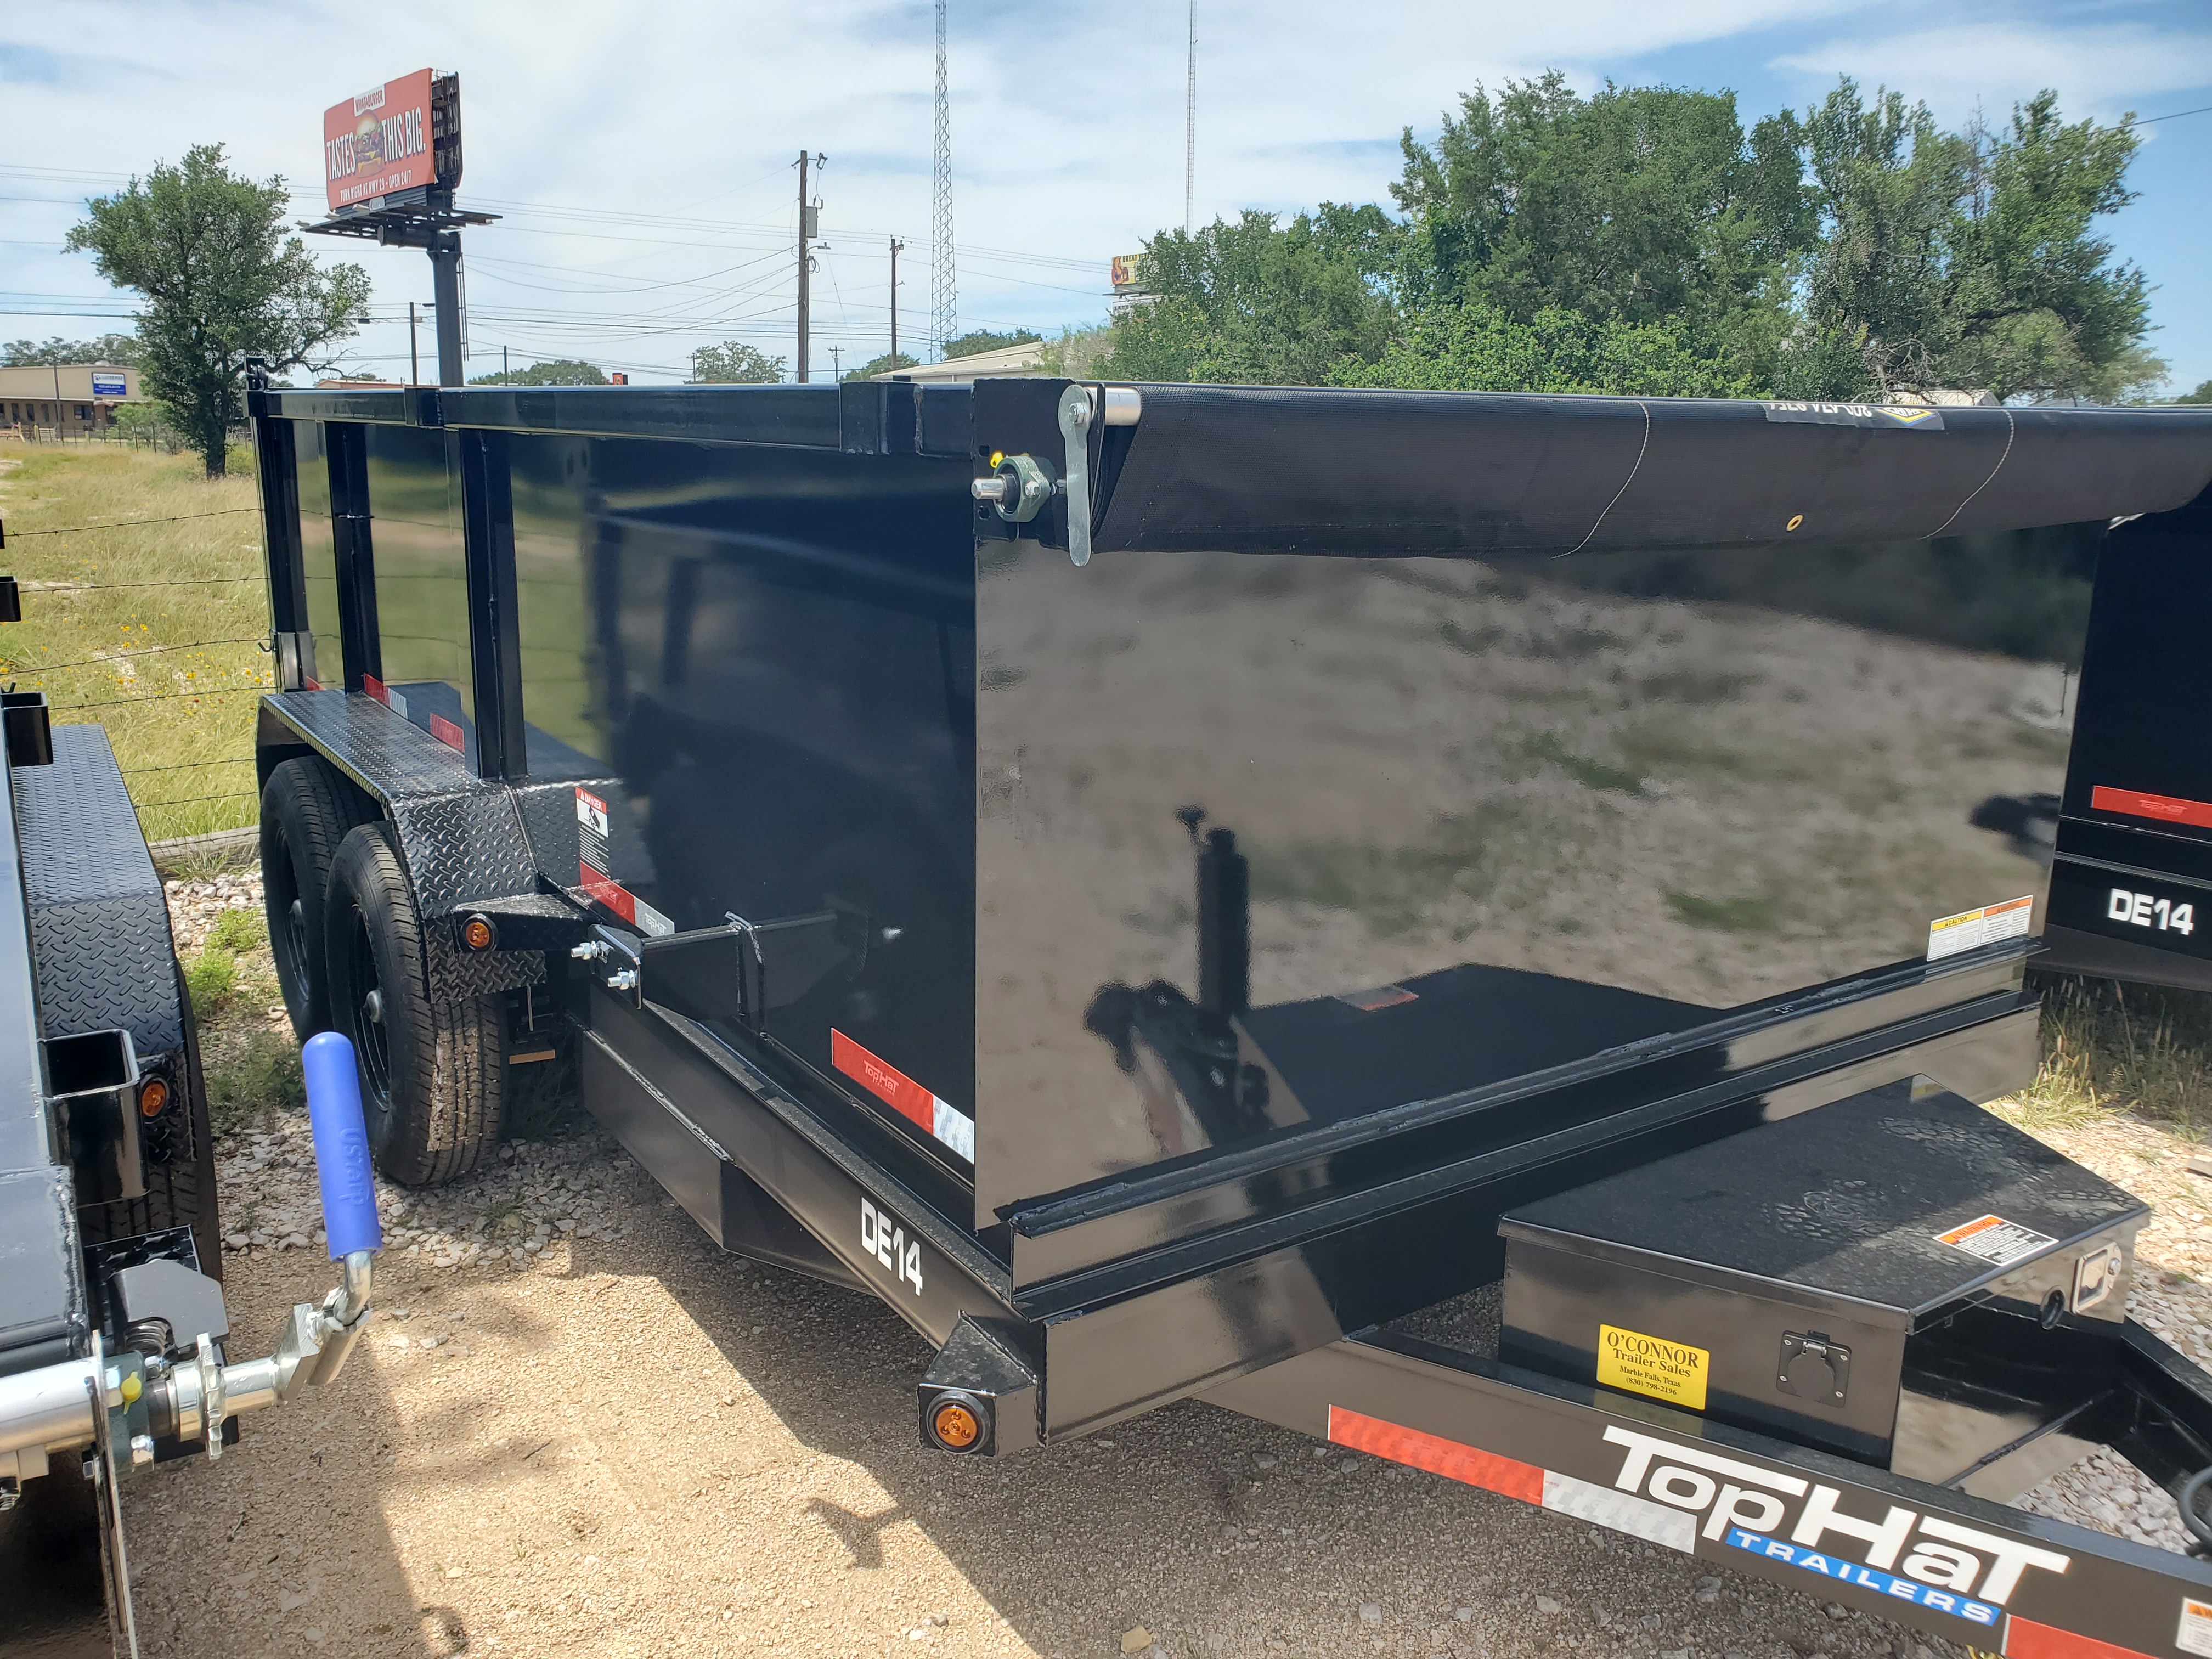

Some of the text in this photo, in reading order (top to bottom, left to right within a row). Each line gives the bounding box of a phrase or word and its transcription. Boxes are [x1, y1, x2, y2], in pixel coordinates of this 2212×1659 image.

[356, 90, 383, 113] WHATABURGER
[326, 106, 426, 180] TASTES THIS BIG.
[340, 188, 350, 202] TURN
[351, 184, 362, 199] RIGHT
[363, 182, 368, 196] AT
[389, 173, 400, 189] OPEN
[401, 169, 411, 185] 24/7
[1122, 254, 1138, 262] GREAT
[585, 793, 602, 811] DANGER
[1949, 916, 1967, 926] CAUTION
[2108, 888, 2194, 936] DE14
[861, 1197, 923, 1296] DE14
[1607, 1331, 1699, 1369] O'CONNOR
[1613, 1348, 1691, 1378] Trailer Sales
[1620, 1365, 1681, 1387] Marble Falls, Texas
[1626, 1377, 1677, 1395] (830) 798-2196
[1736, 1531, 1994, 1623] TRAILERS
